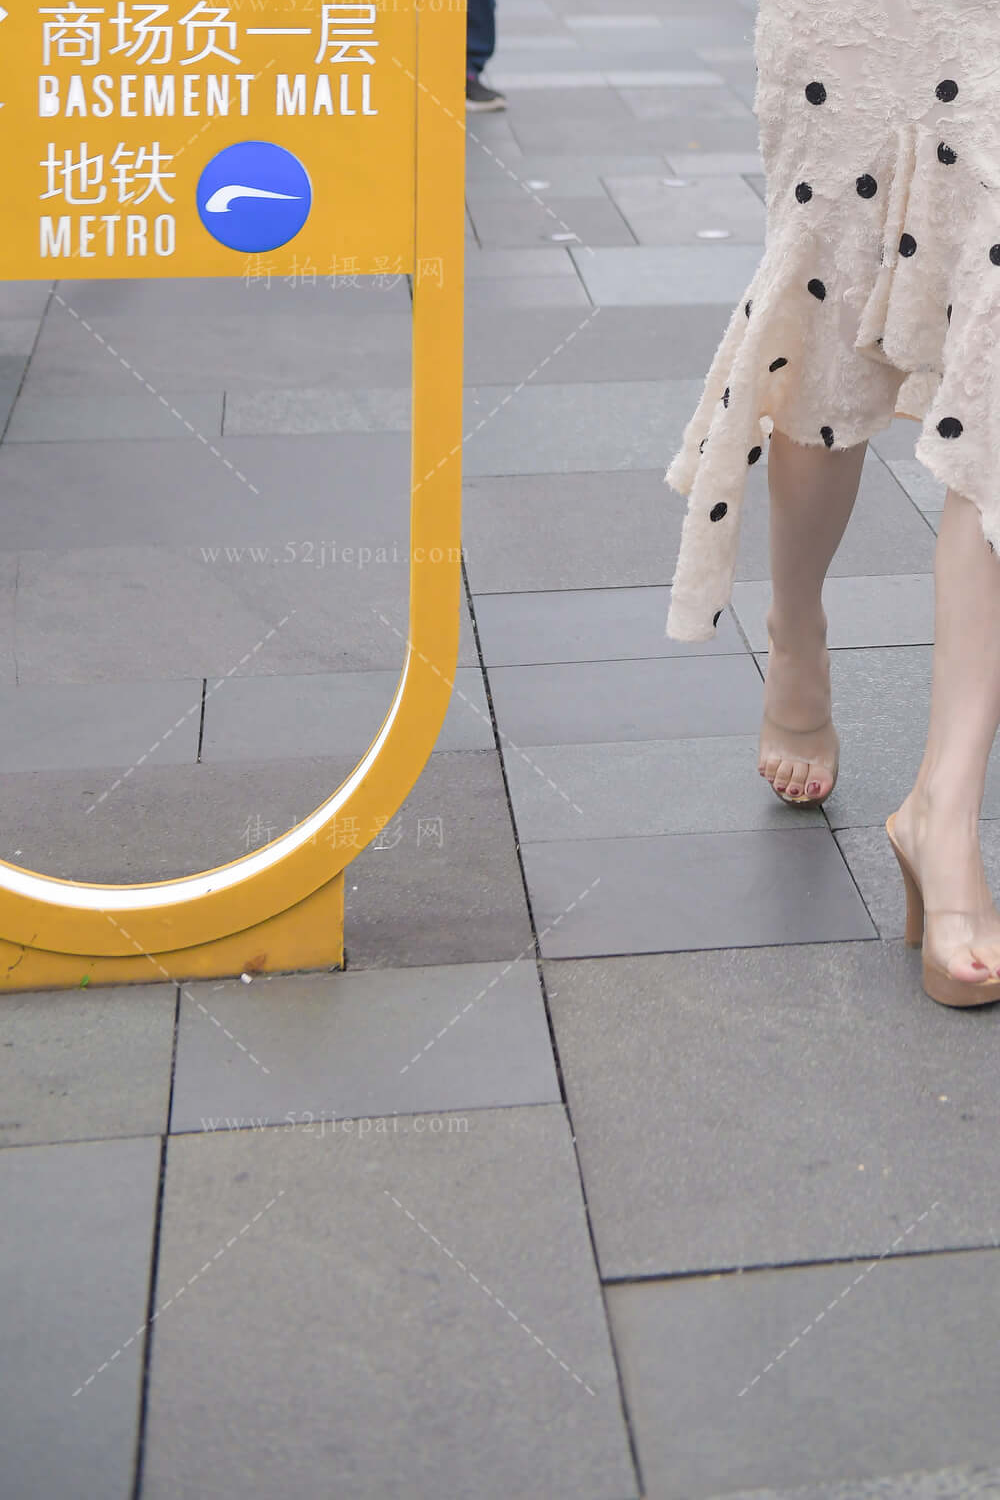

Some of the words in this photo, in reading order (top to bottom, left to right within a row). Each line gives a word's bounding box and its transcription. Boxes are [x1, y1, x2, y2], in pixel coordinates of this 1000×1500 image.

[38, 1, 379, 65] 商场负一层
[38, 74, 256, 117] BASEMENT
[276, 74, 379, 116] MALL
[39, 141, 177, 205] 地铁
[39, 214, 176, 258] METRO
